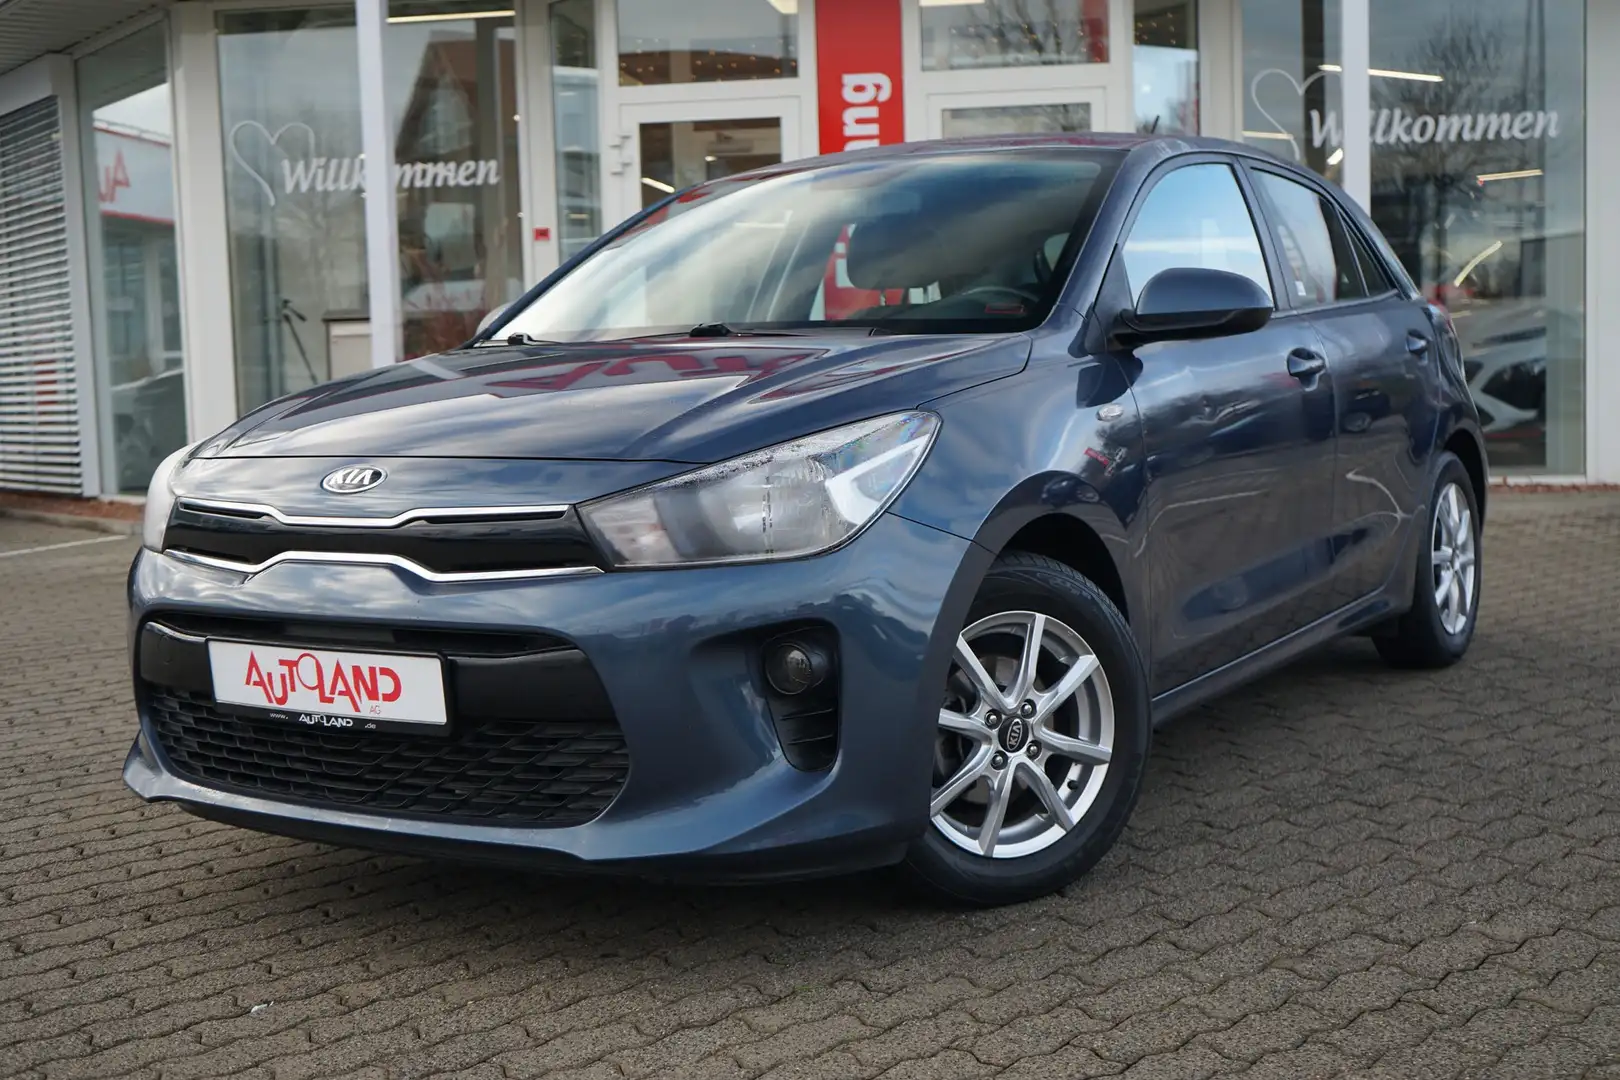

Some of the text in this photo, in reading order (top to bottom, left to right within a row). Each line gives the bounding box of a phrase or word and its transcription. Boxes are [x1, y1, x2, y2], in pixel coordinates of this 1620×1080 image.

[281, 156, 499, 194] Willkmmen
[328, 468, 375, 485] KIA
[244, 650, 403, 713] AUTOLAND
[369, 705, 382, 715] AG
